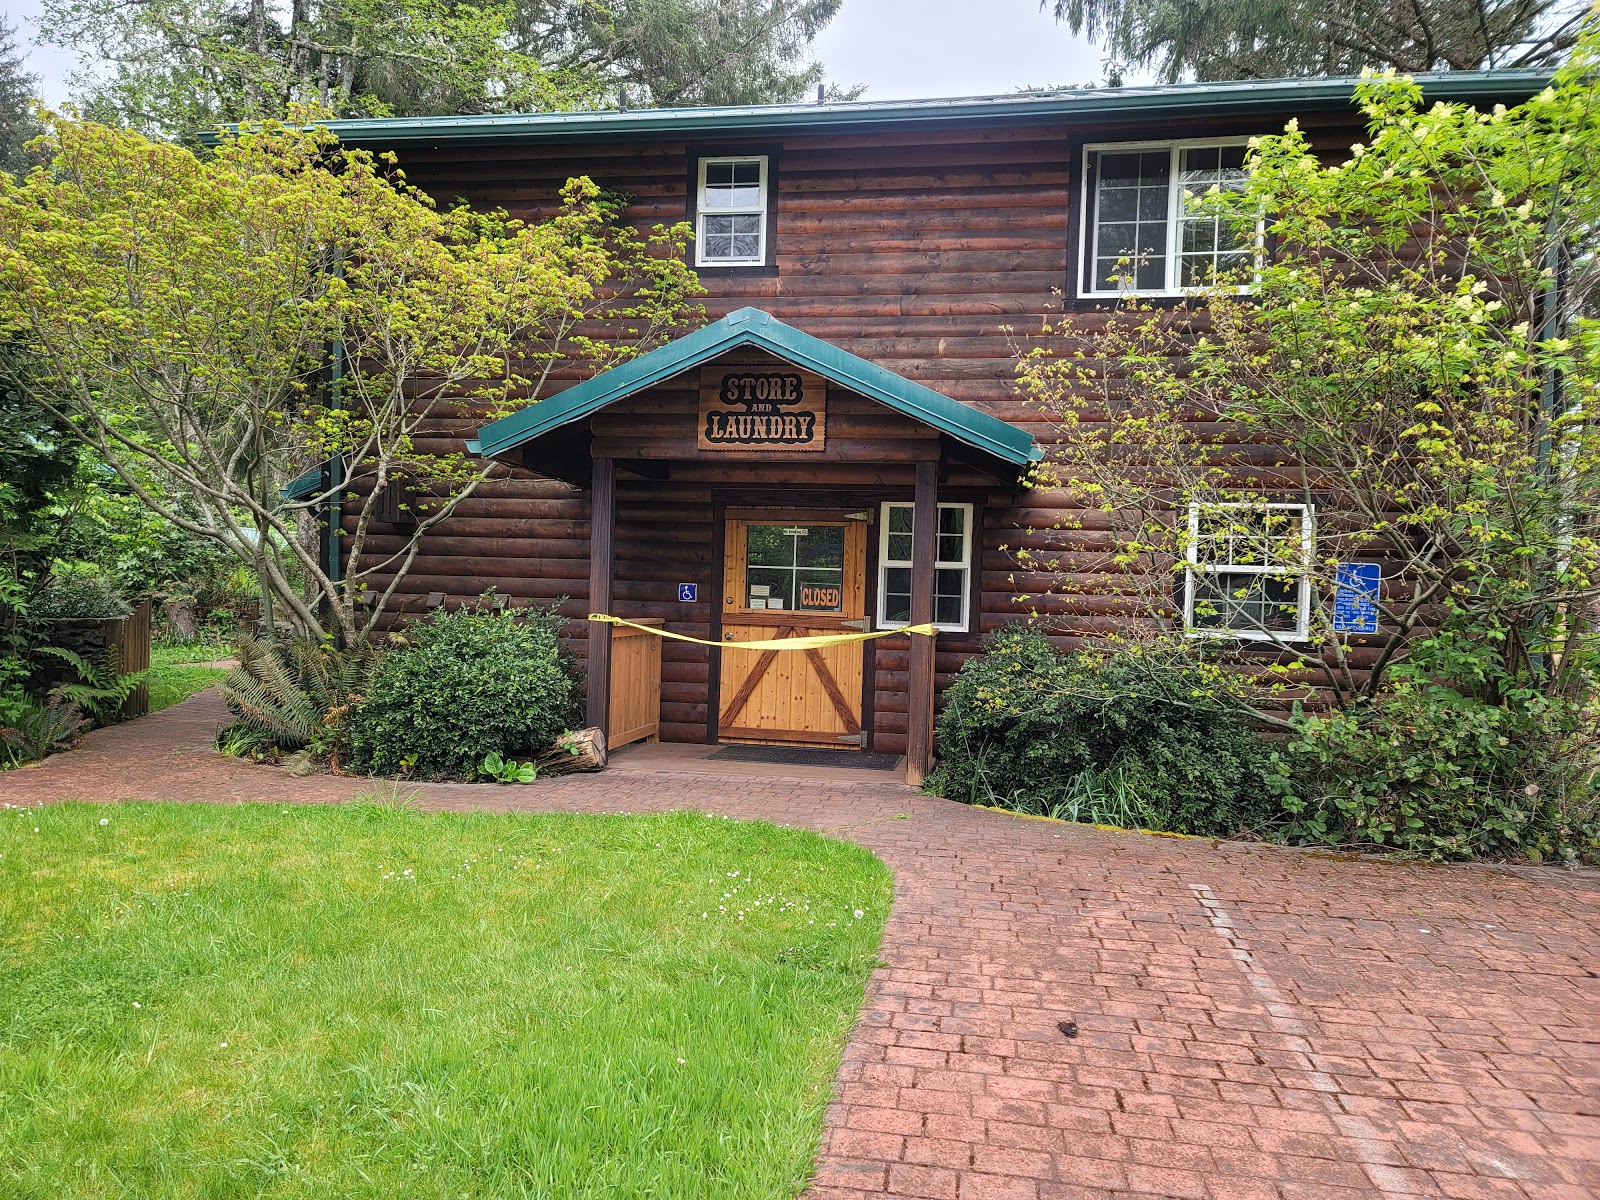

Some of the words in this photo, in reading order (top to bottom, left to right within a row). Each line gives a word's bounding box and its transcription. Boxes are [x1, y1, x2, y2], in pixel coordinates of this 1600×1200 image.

[726, 377, 798, 400] STORE
[751, 403, 772, 412] AND
[710, 415, 812, 439] LAUNDRY
[801, 587, 839, 607] CLOSED
